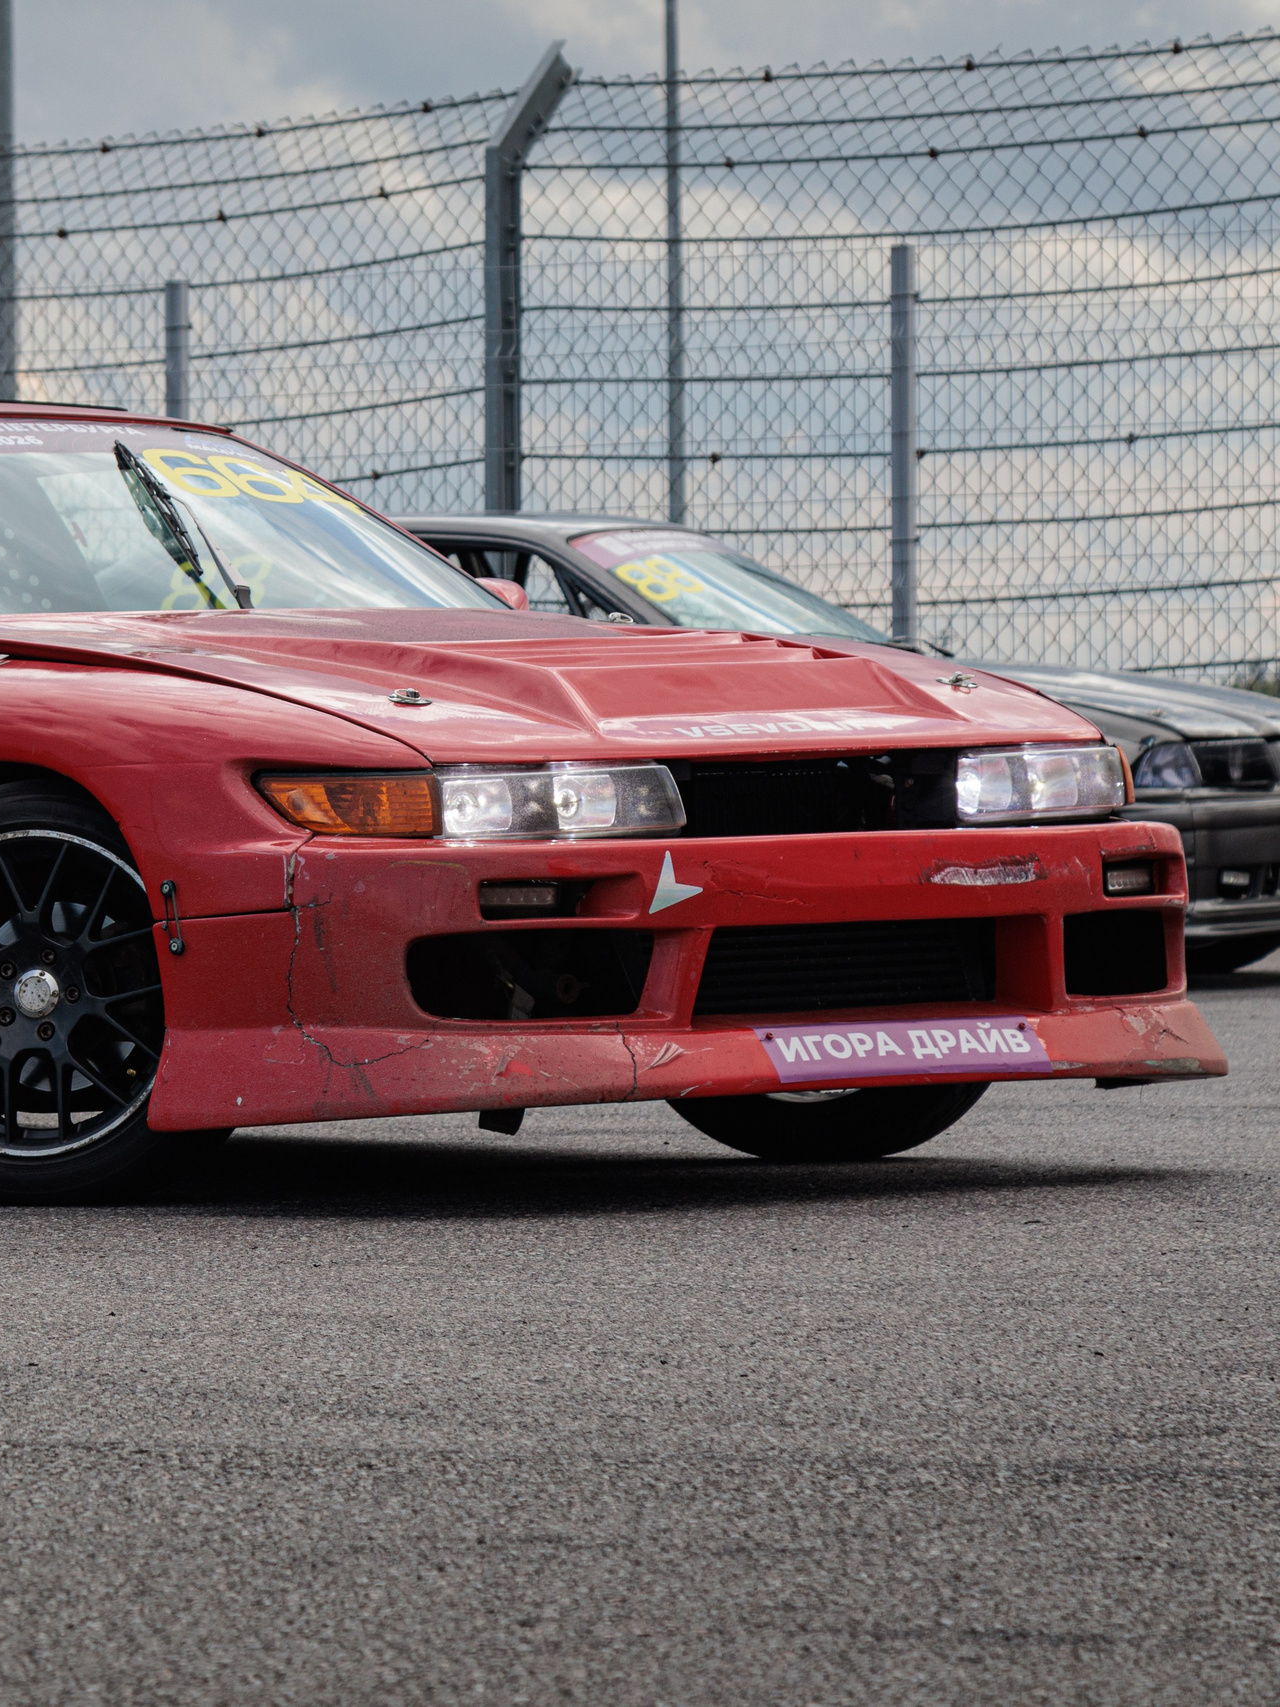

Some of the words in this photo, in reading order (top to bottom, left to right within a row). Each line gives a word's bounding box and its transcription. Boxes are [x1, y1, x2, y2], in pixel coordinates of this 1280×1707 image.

[616, 558, 705, 602] 88
[775, 1031, 905, 1063] ИГОРА
[907, 1022, 1032, 1060] ДРАЙВ
